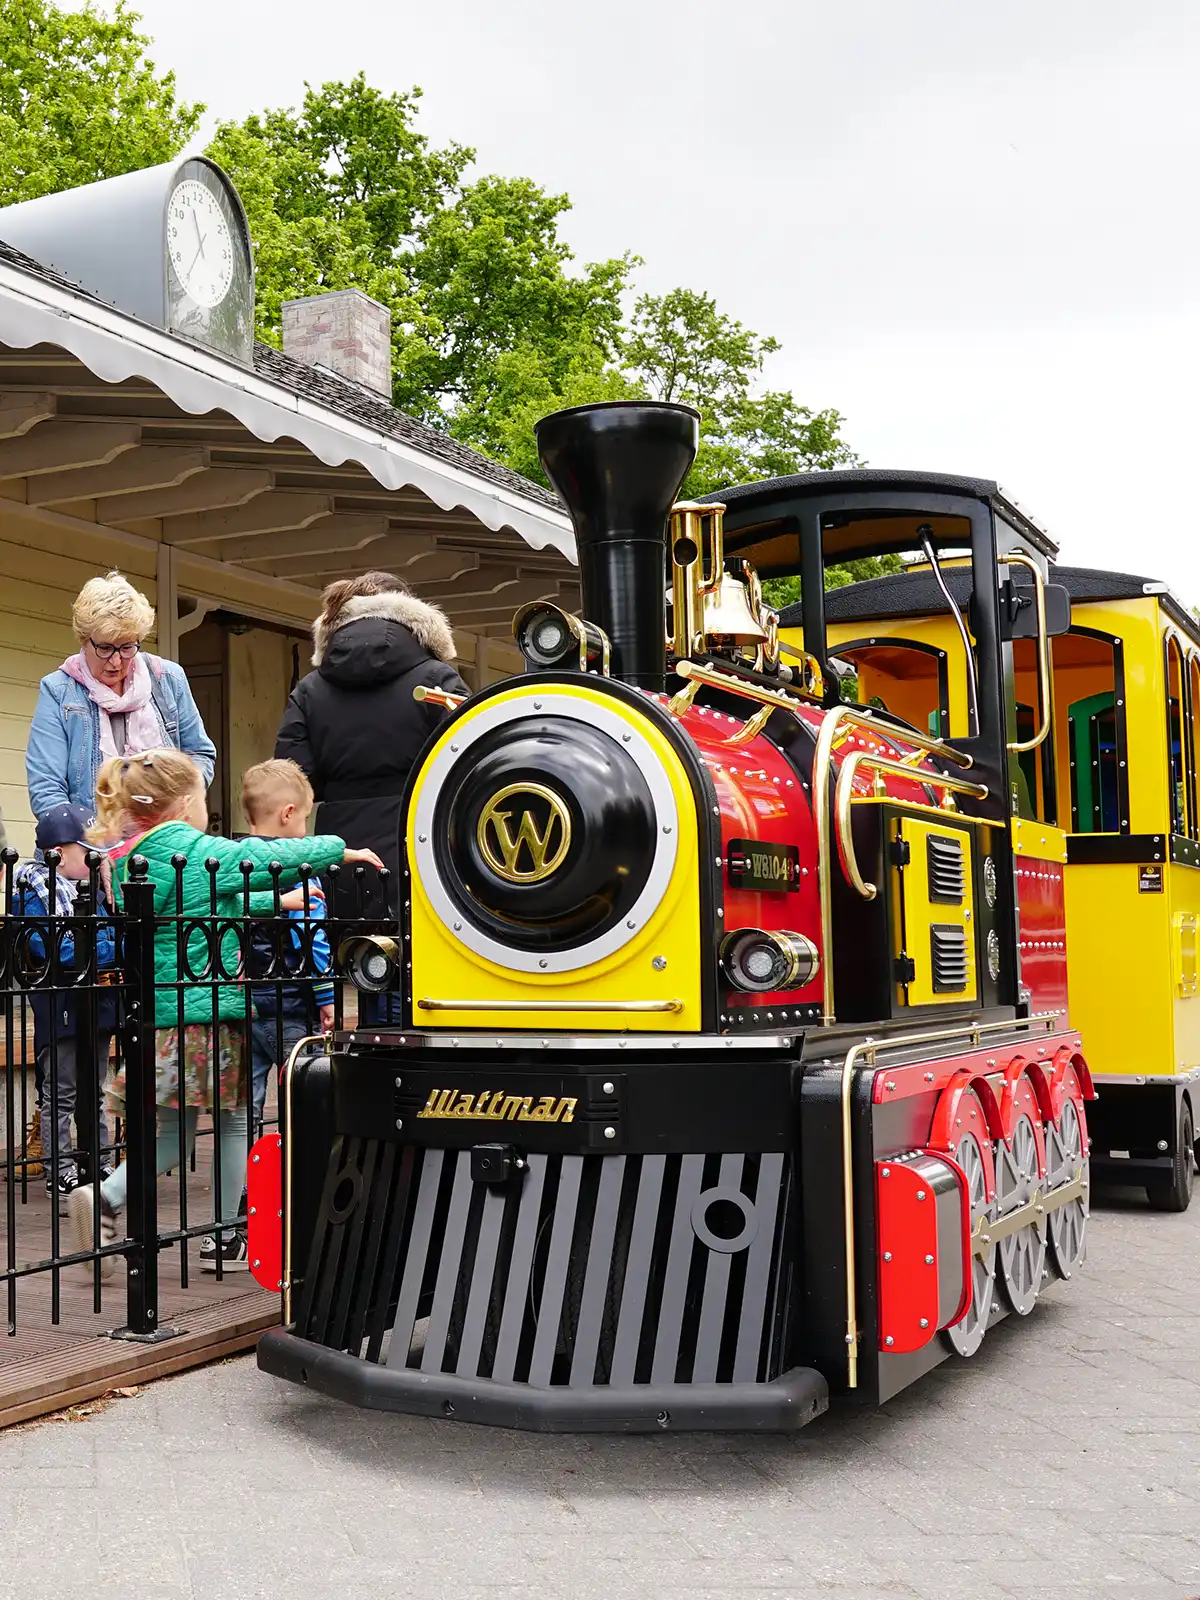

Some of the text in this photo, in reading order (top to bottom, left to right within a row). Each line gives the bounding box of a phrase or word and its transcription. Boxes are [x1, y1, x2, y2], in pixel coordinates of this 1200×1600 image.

[181, 194, 192, 207] 11
[193, 191, 204, 204] 12
[174, 207, 185, 220] 10
[208, 203, 213, 214] 1
[171, 227, 178, 238] 9
[217, 224, 223, 235] 2
[176, 252, 182, 262] 8
[221, 249, 228, 260] 3
[218, 269, 225, 280] 4
[484, 802, 563, 874] W
[416, 1088, 578, 1122] Wattman
